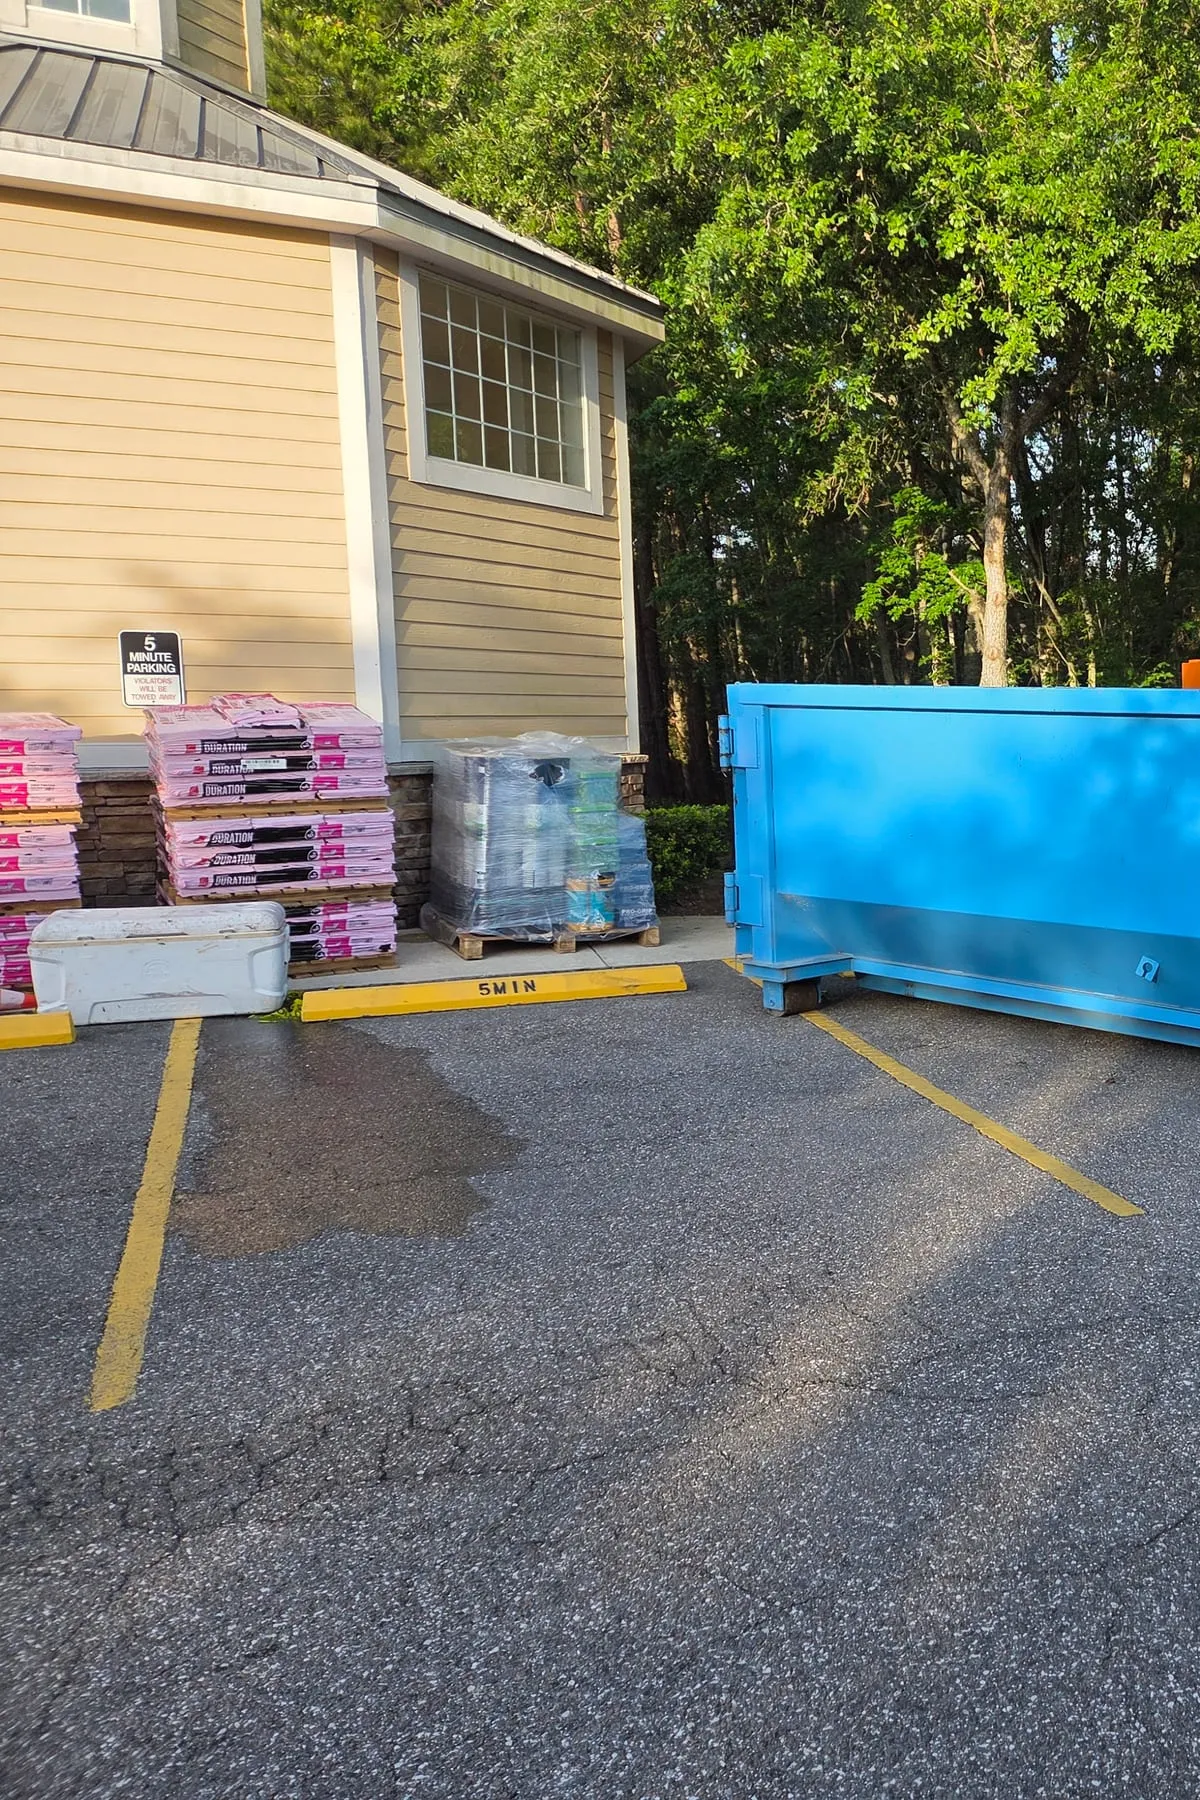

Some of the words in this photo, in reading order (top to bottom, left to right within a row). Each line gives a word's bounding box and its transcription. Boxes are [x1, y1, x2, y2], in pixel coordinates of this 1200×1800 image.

[143, 636, 156, 651] 5
[129, 652, 173, 662] MINUTE
[126, 663, 177, 673] PARKING
[134, 677, 173, 685] VIOLATORS
[158, 685, 168, 693] BE
[131, 693, 156, 701] TOWED
[203, 743, 248, 753] DURATION
[204, 784, 246, 796] DURATION
[211, 831, 254, 845] DURATION
[213, 853, 256, 866] DURATION
[215, 875, 257, 886] DURATION
